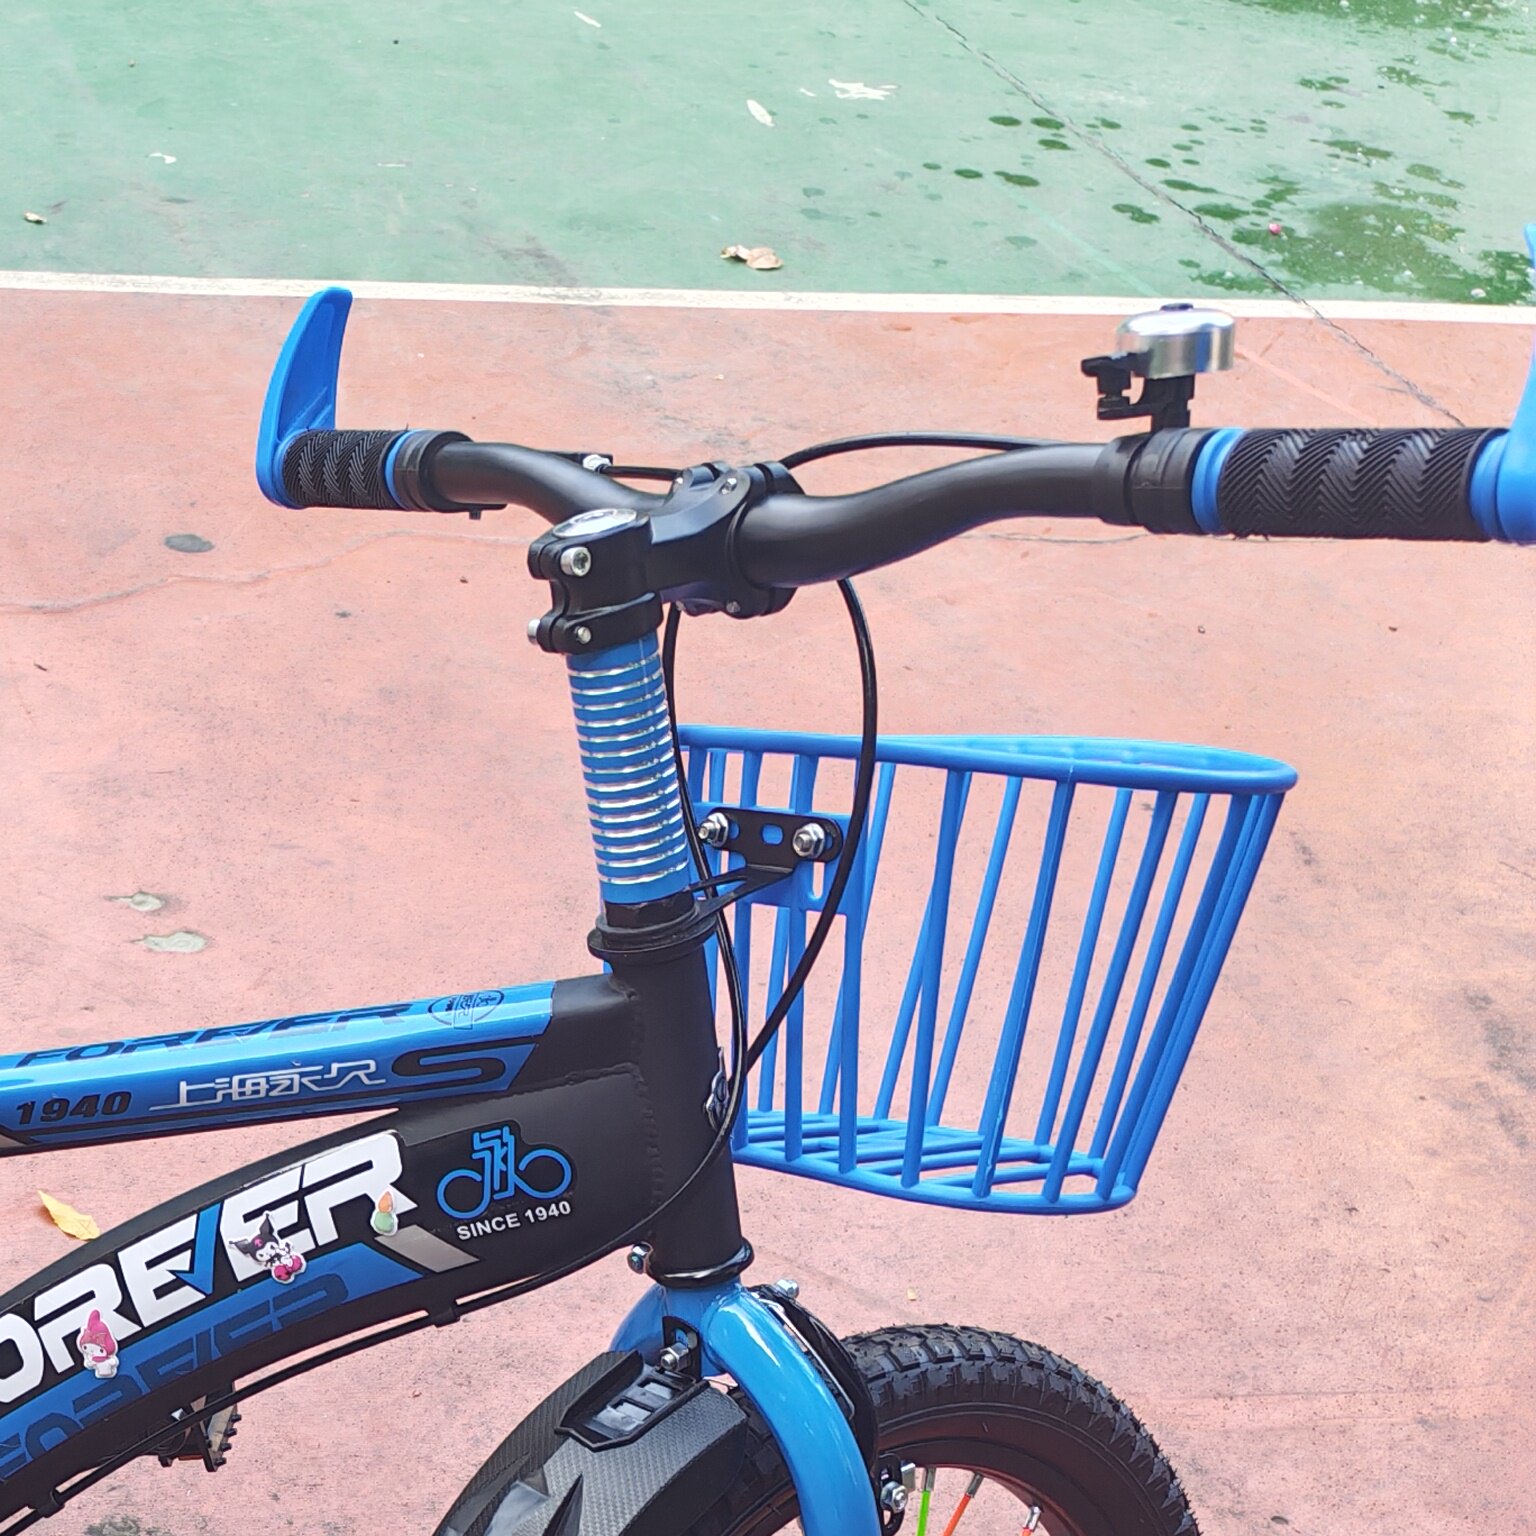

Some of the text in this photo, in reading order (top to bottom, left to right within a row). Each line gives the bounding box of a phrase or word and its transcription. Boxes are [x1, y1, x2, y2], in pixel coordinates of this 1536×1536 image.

[149, 1059, 387, 1110] 上海永久
[15, 1091, 133, 1126] 1940
[456, 1201, 572, 1240] SINCE 1940
